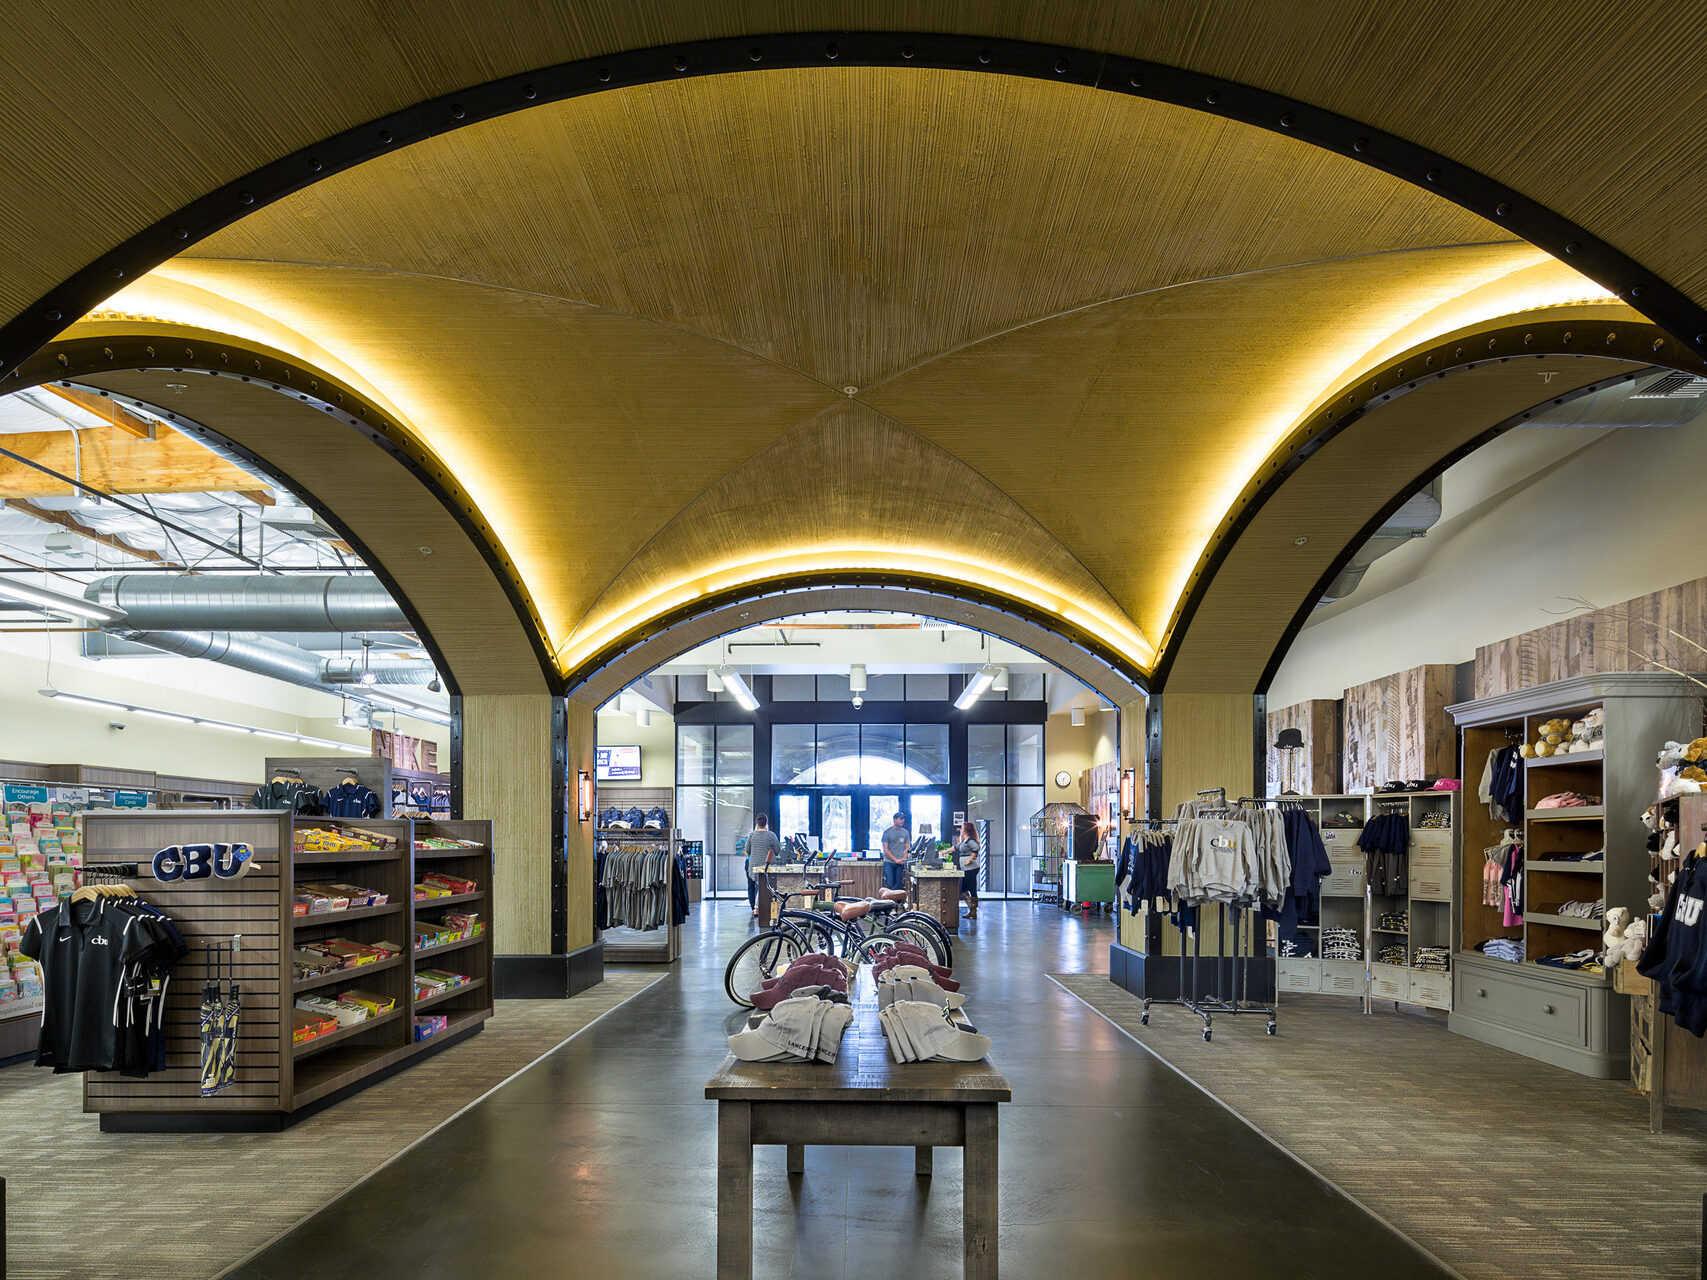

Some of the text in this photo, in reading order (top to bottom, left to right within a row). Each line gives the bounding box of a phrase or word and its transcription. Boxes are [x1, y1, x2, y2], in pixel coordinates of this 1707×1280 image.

[372, 728, 438, 774] NIKE
[11, 788, 40, 796] Encourage
[1210, 834, 1237, 849] cbu
[152, 842, 250, 882] CBU
